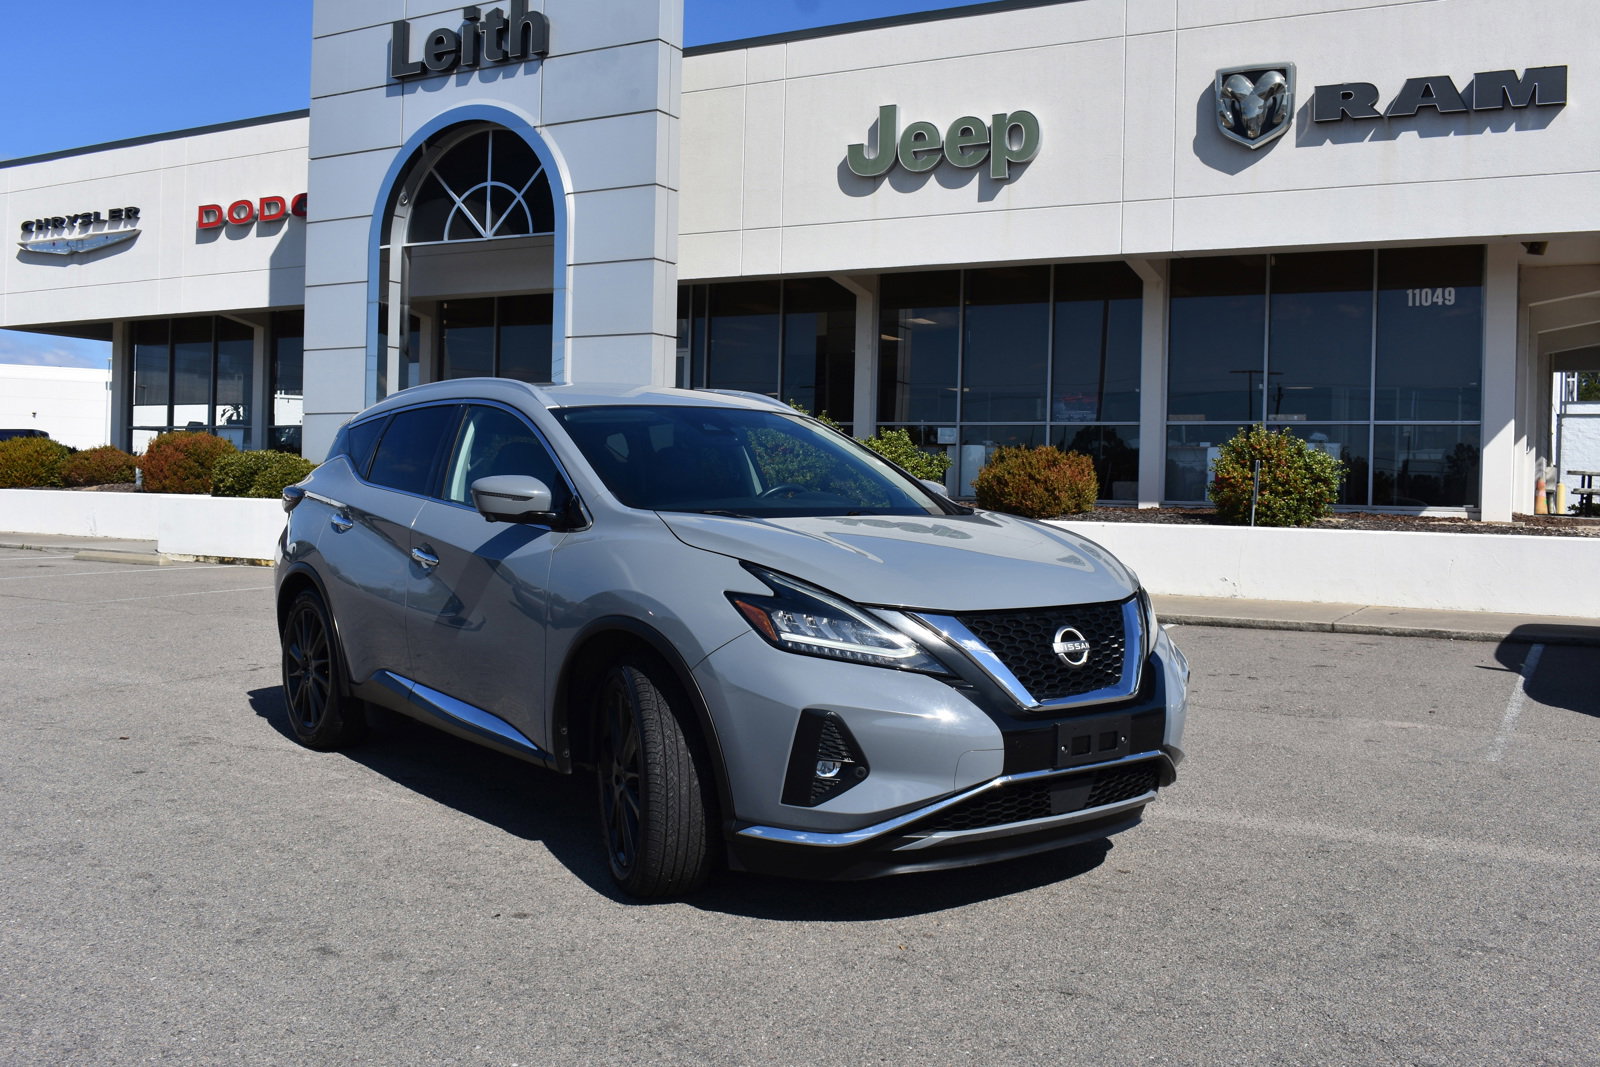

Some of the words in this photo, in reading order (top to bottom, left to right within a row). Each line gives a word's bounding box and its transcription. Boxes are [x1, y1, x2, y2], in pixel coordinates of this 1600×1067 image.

[391, 0, 549, 79] Leith
[1314, 64, 1568, 122] RAM
[847, 104, 1041, 179] Jeep
[20, 206, 141, 232] CHRYSLER
[1406, 286, 1456, 307] 11049
